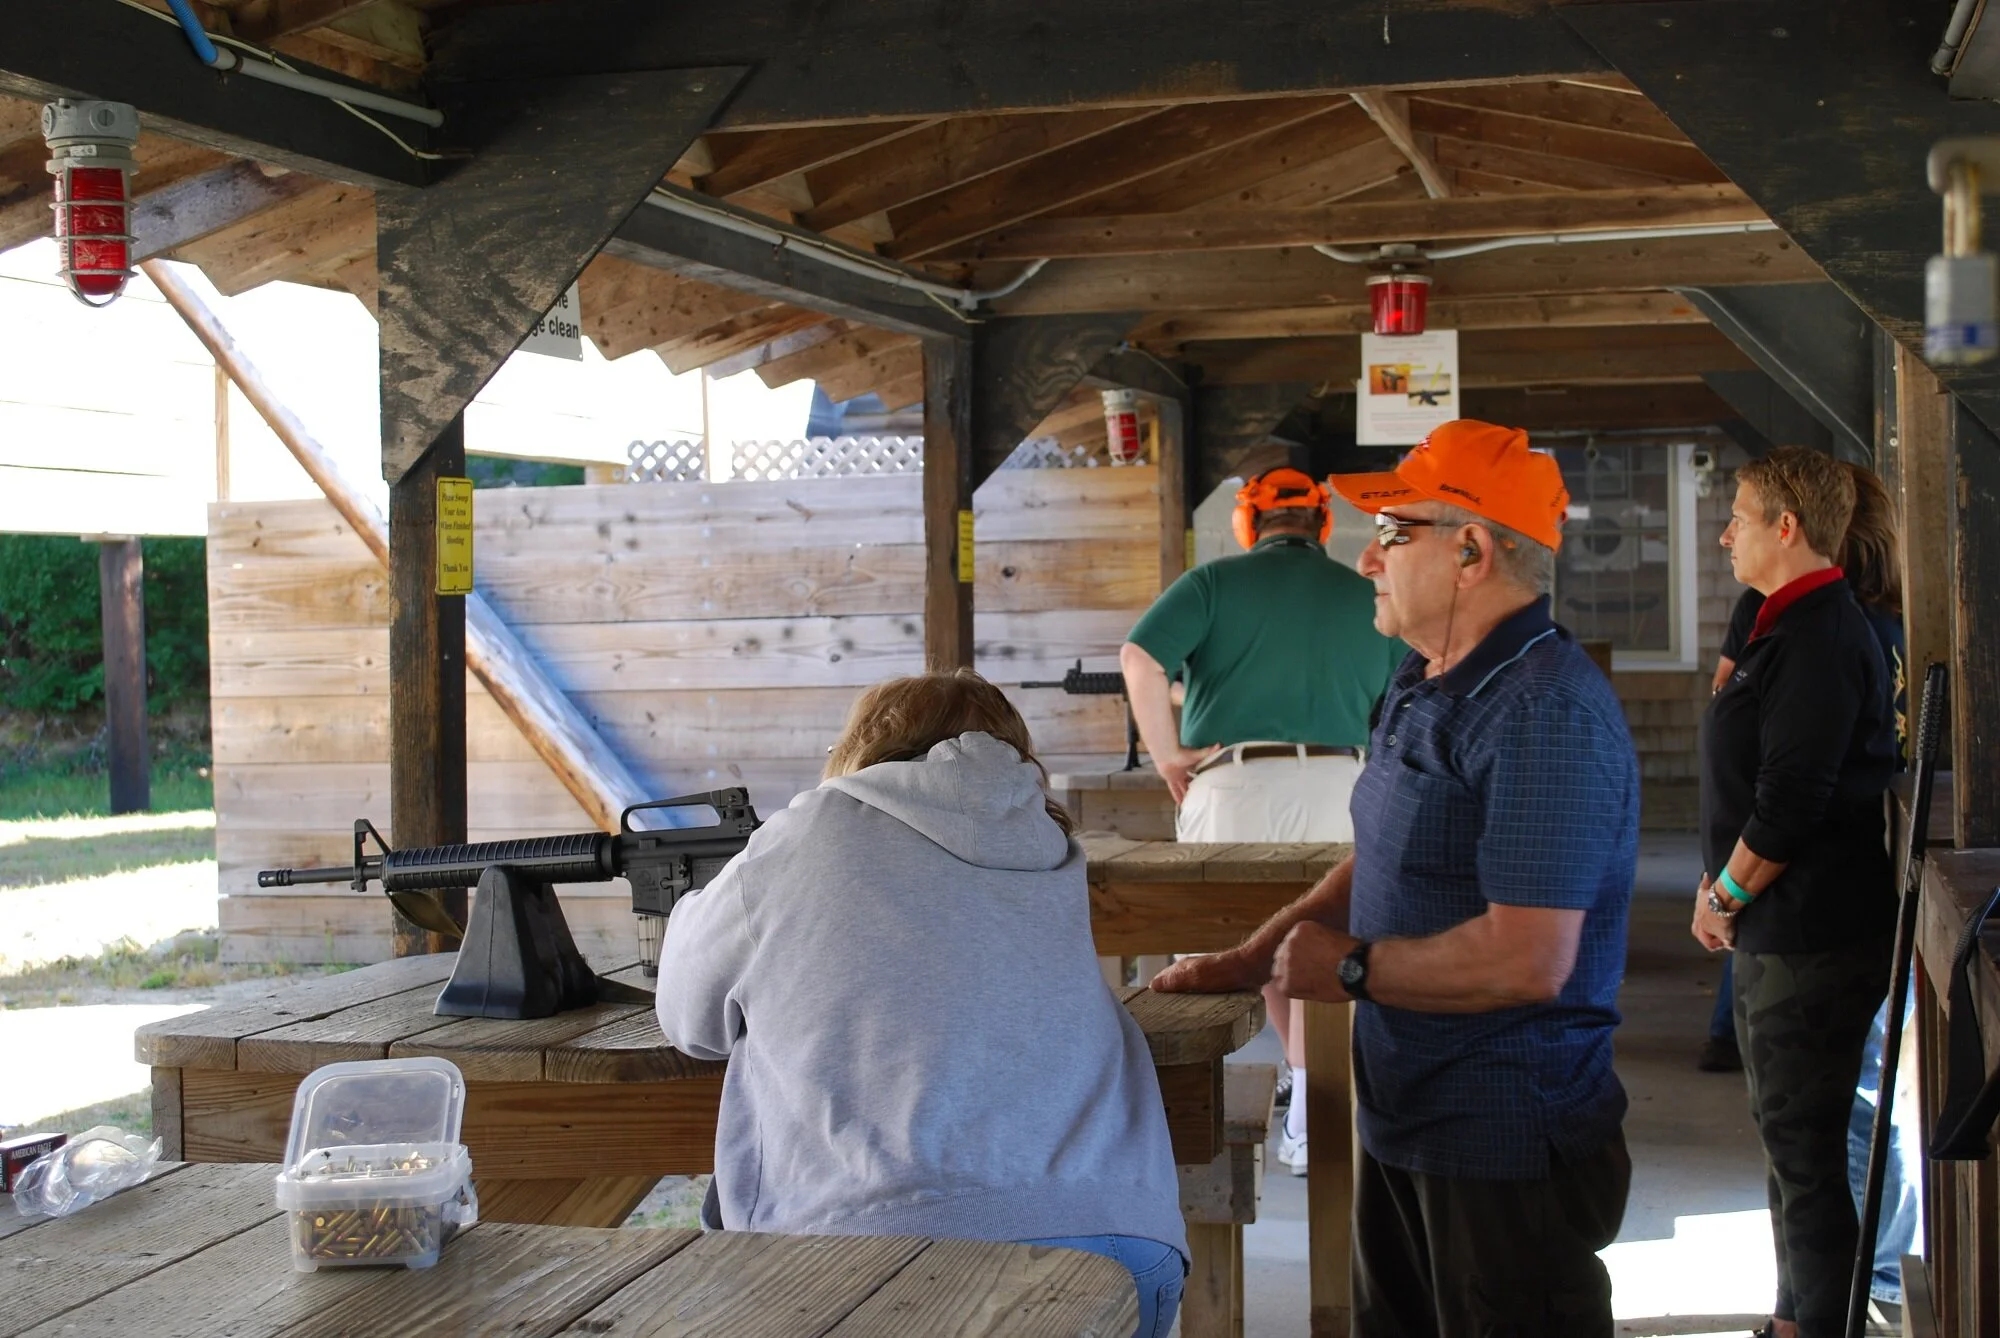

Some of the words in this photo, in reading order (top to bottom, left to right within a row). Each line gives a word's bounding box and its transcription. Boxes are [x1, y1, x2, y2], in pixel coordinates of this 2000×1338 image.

[548, 315, 579, 340] clean
[1360, 488, 1412, 500] STAFF
[443, 562, 458, 573] Thank
[11, 1145, 37, 1160] AMERICAN
[38, 1141, 52, 1153] EAGLE
